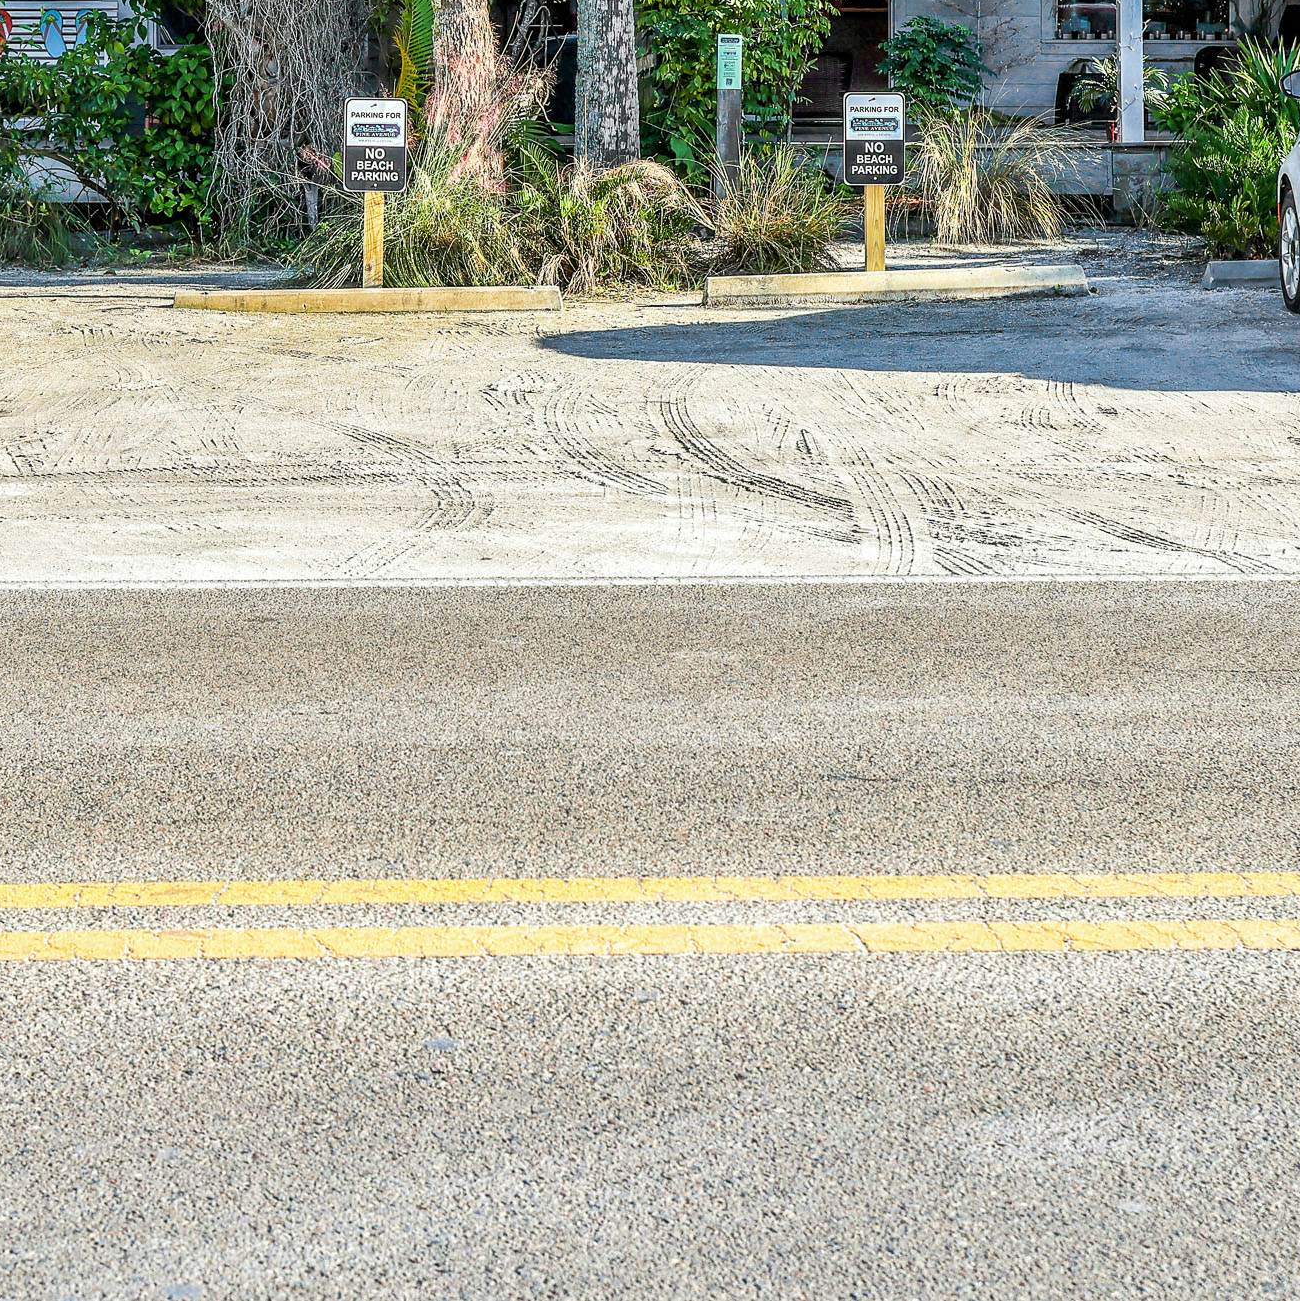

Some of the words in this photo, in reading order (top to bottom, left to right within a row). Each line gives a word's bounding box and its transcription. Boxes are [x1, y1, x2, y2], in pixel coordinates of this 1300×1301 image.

[865, 142, 885, 153] NO
[365, 147, 385, 160] NO
[856, 154, 893, 164] BEACH
[356, 160, 394, 171] BEACH
[851, 165, 898, 175] PARKING
[351, 171, 399, 182] PARKING
